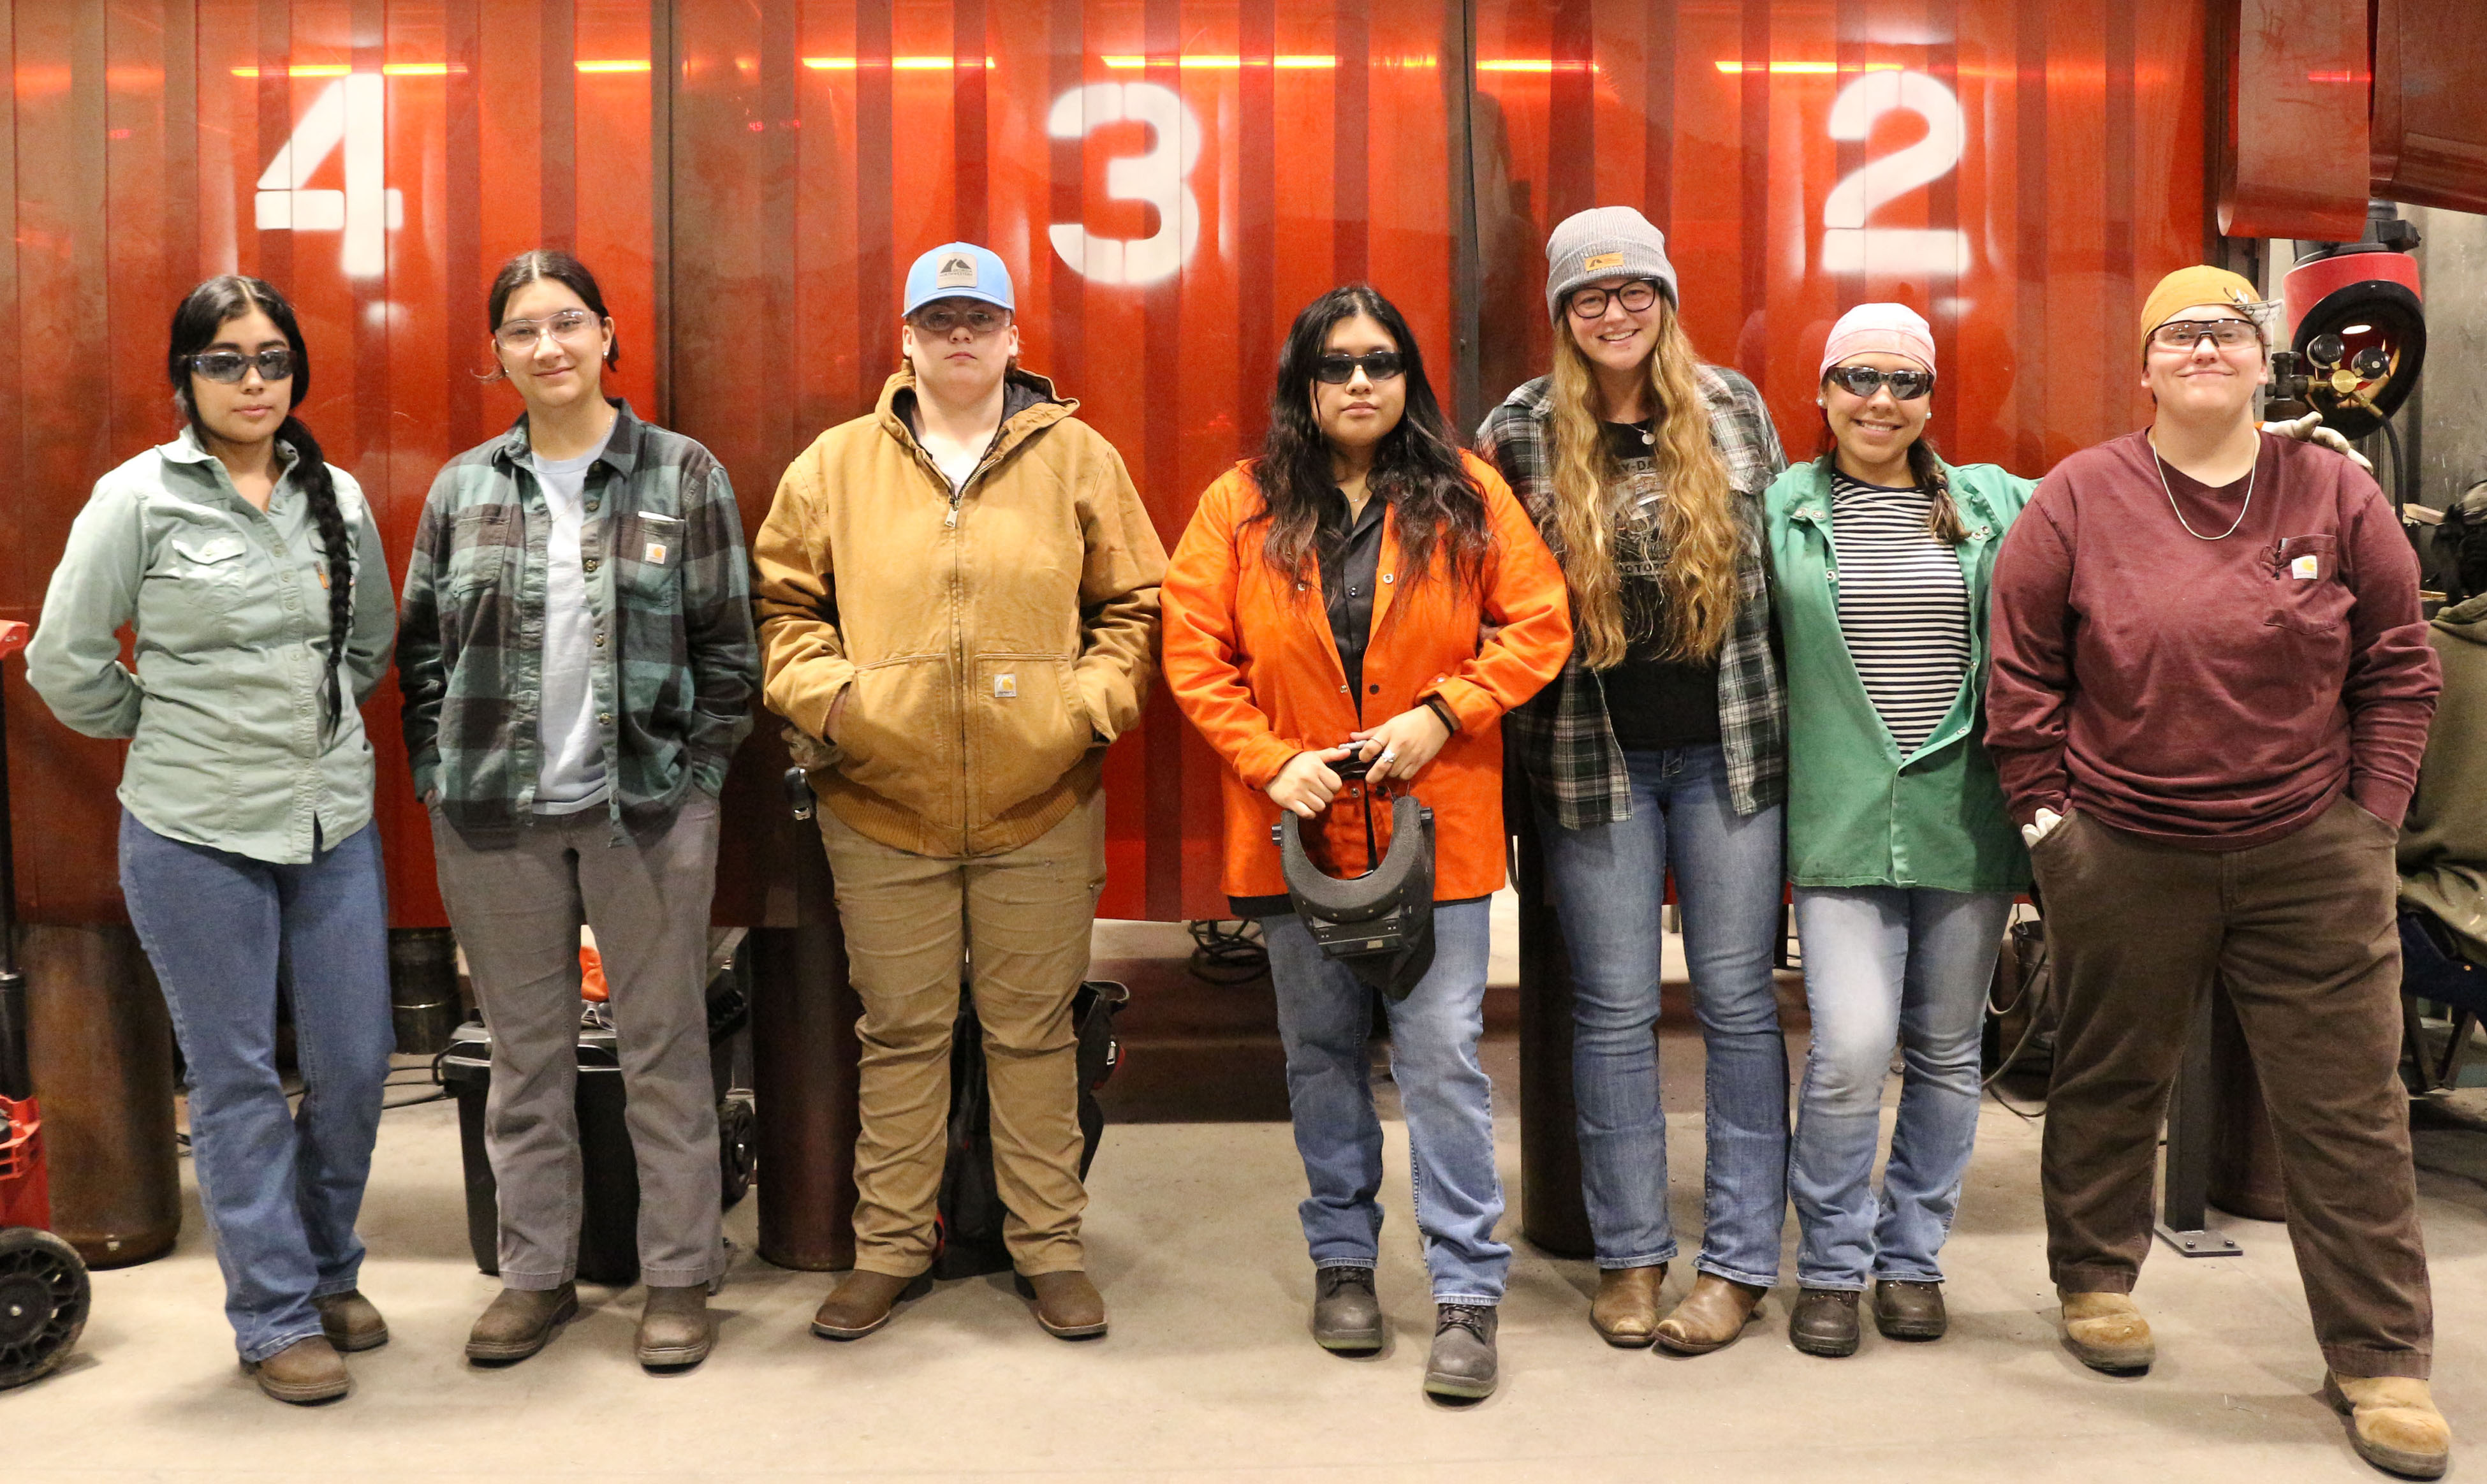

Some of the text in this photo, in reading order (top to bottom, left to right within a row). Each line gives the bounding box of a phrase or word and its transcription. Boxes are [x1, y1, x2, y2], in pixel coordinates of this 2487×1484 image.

[254, 73, 402, 277] 4
[1048, 82, 1200, 284] 3
[1822, 70, 1971, 274] 2
